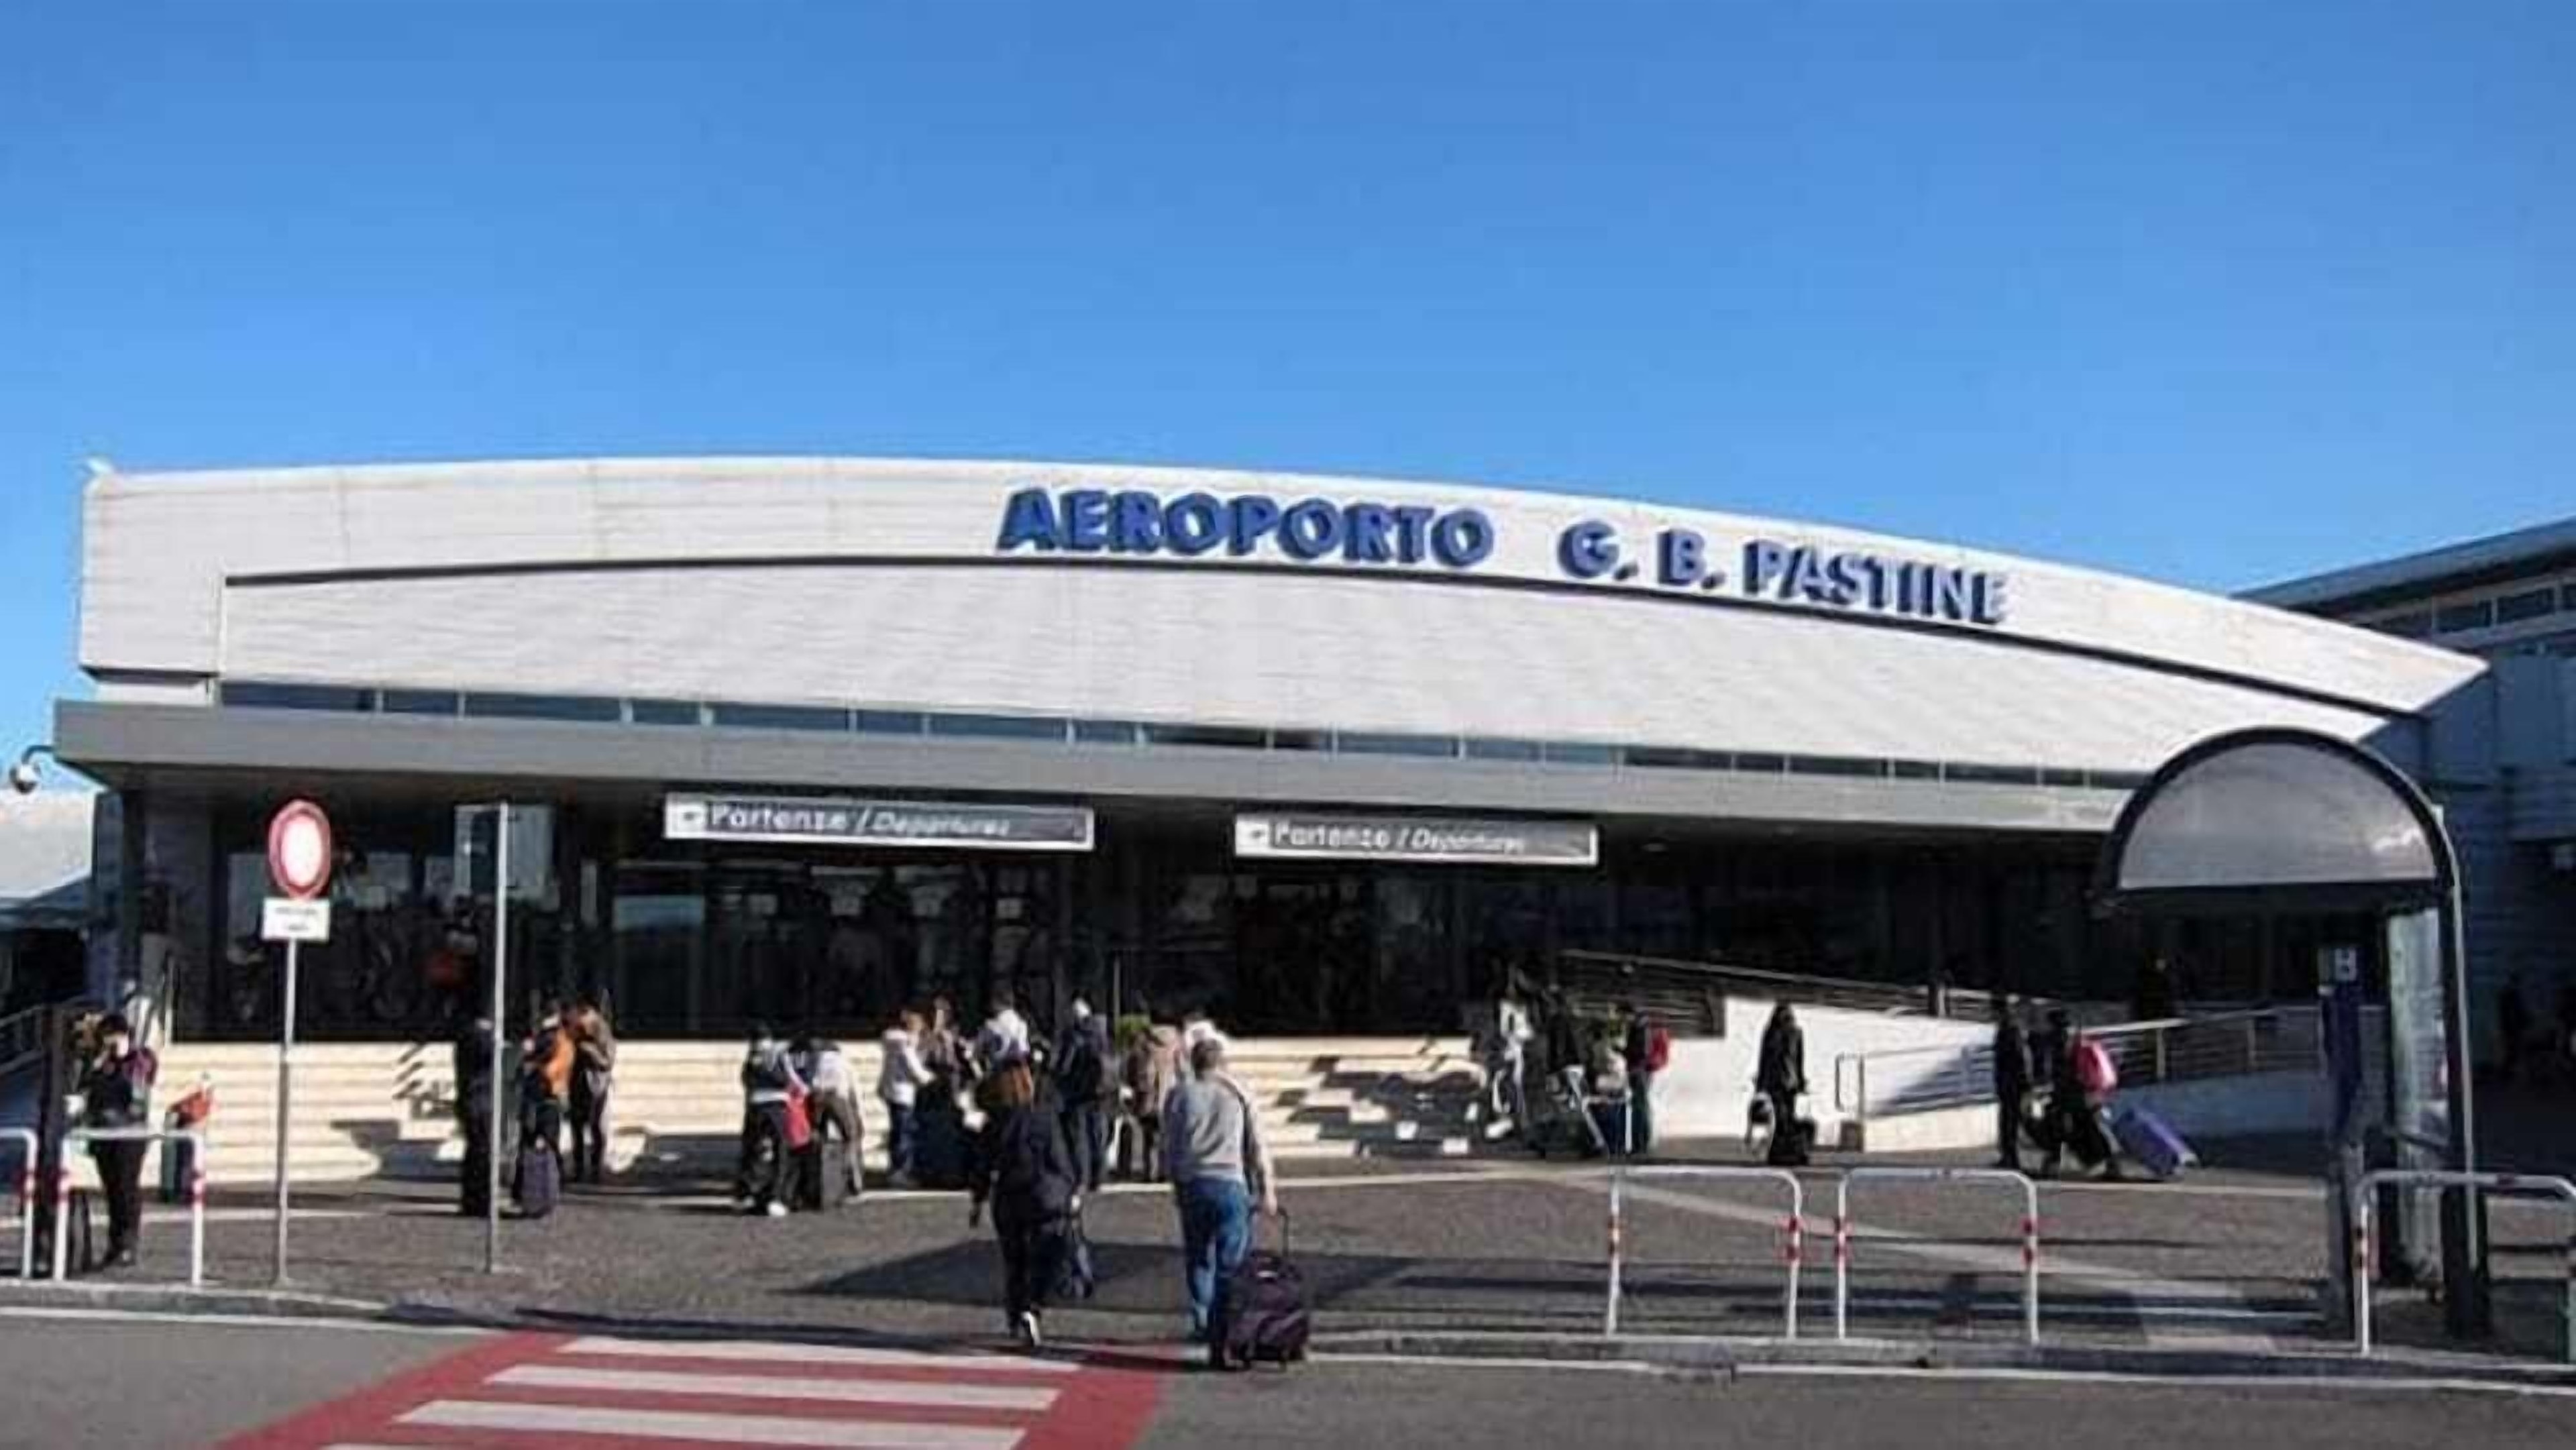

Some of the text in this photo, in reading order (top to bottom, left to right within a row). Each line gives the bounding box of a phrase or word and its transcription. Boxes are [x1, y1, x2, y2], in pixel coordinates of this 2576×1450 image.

[996, 487, 2008, 624] AEROPORTO G. B. PASTINE
